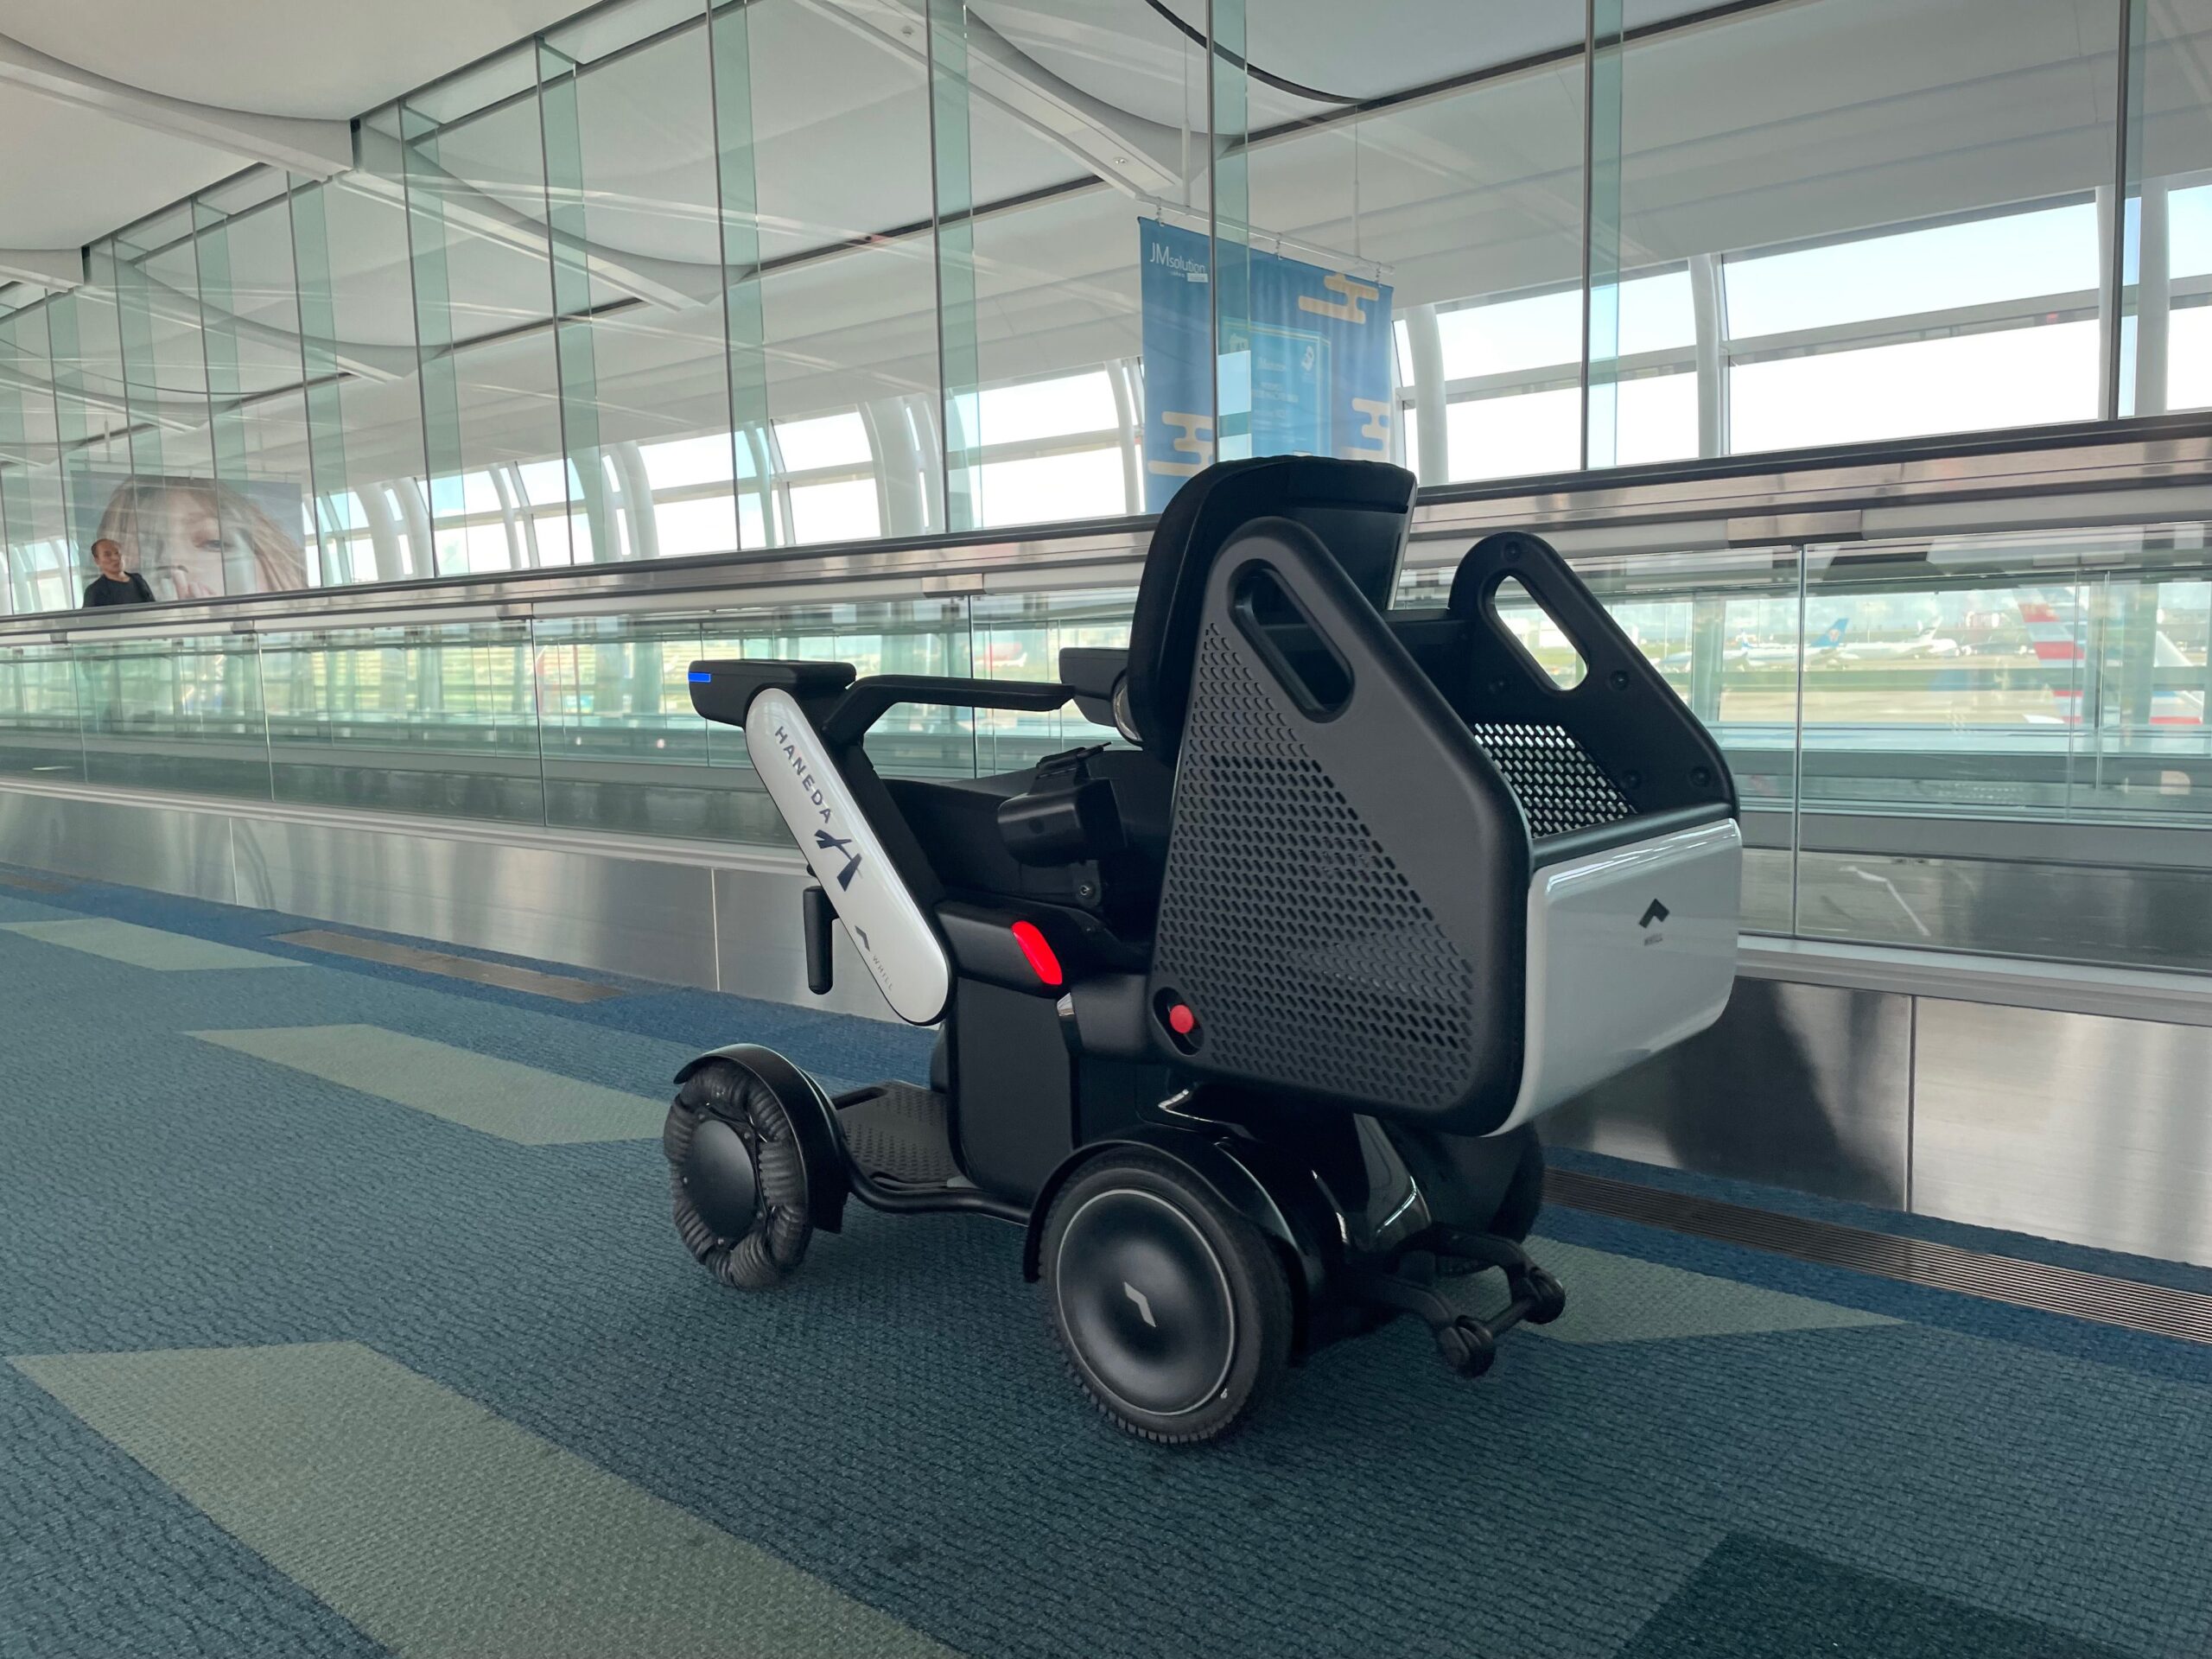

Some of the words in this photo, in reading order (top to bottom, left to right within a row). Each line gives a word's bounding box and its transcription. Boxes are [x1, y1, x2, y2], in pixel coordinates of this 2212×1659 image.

[1149, 242, 1206, 274] JMsolution
[774, 726, 832, 823] HANEDA
[873, 954, 893, 992] WHILL
